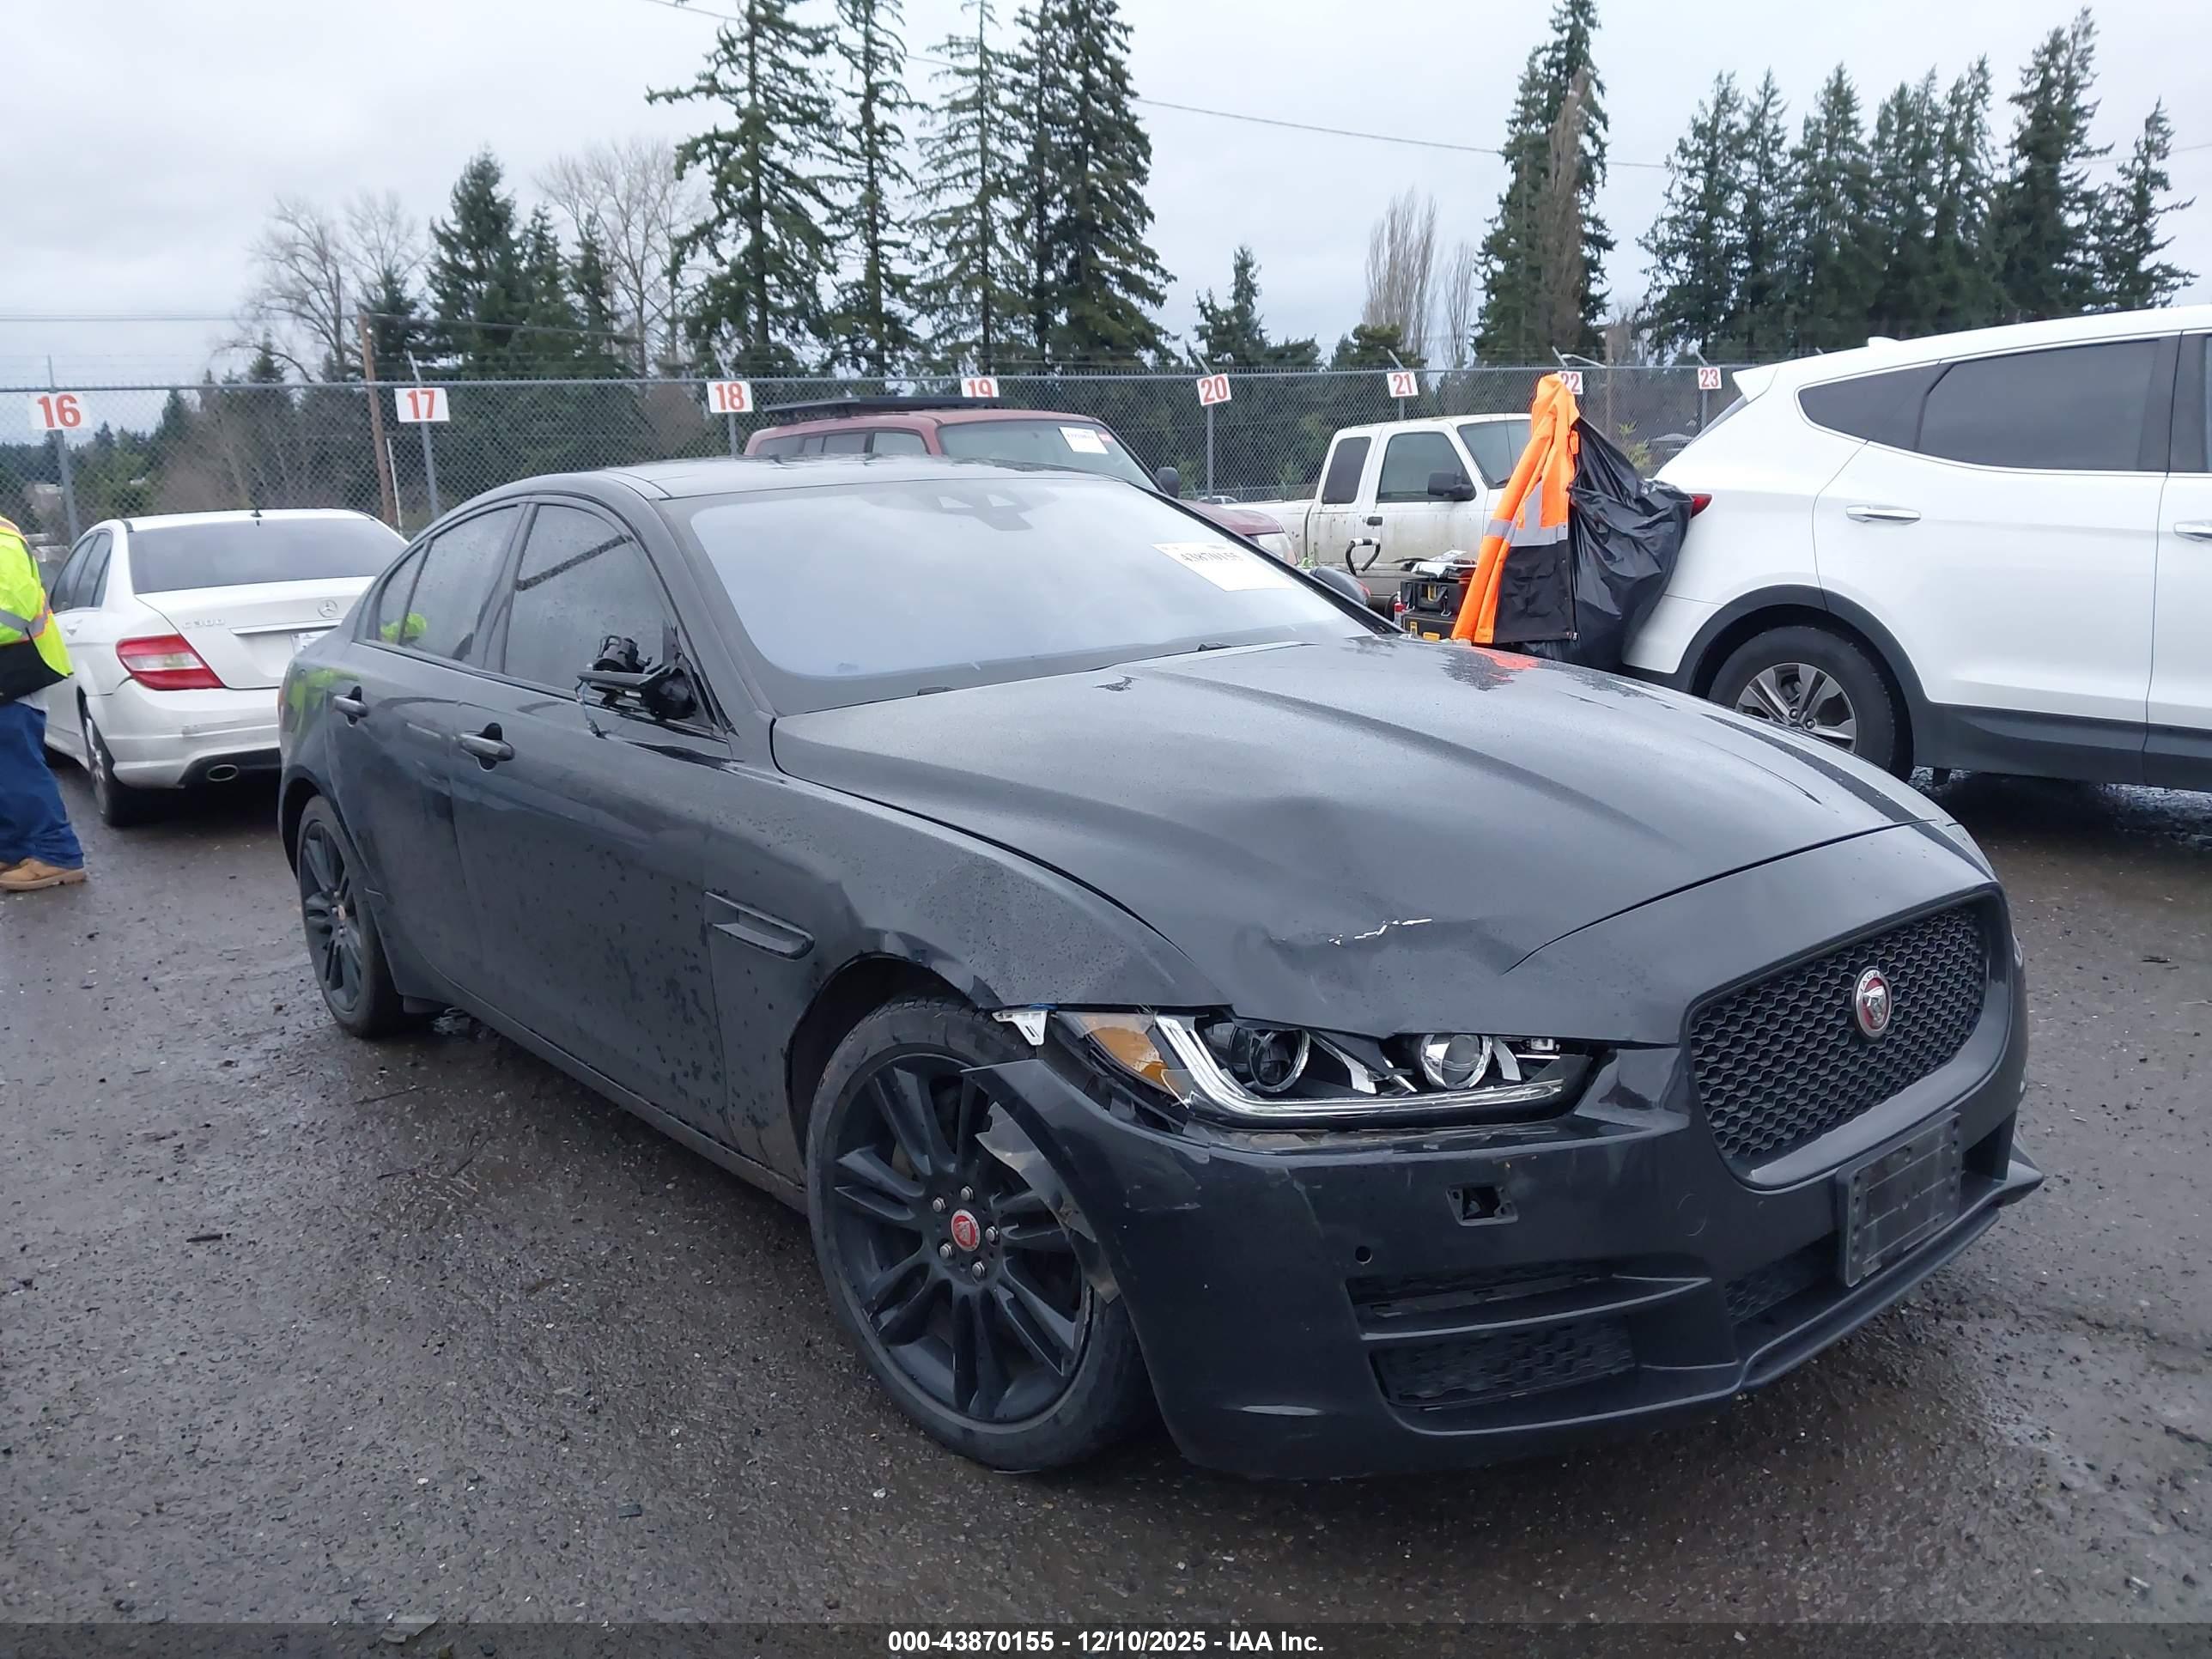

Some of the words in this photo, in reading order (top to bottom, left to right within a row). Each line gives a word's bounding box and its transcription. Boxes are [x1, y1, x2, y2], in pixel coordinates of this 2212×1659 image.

[968, 379, 994, 398] 19
[1200, 376, 1228, 403] 20
[1393, 374, 1413, 395] 21
[1700, 369, 1719, 387] 23
[407, 390, 434, 419] 17
[715, 382, 744, 410] 18
[37, 394, 82, 428] 16
